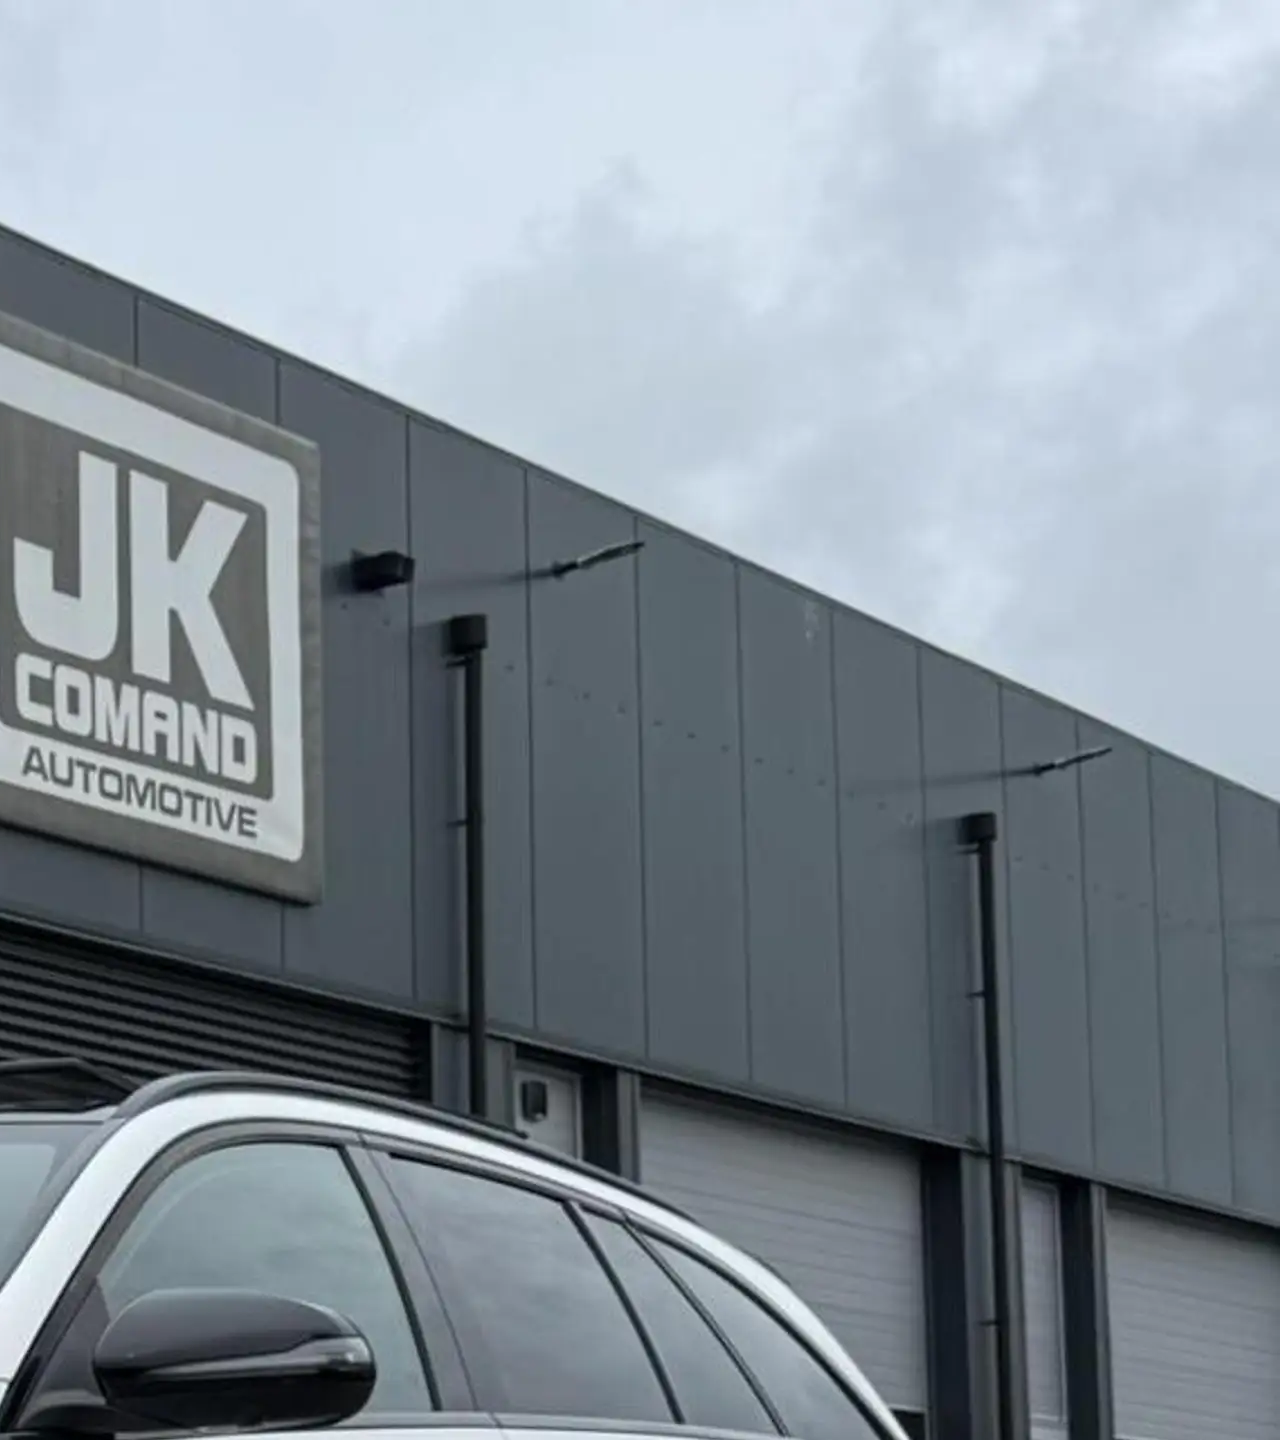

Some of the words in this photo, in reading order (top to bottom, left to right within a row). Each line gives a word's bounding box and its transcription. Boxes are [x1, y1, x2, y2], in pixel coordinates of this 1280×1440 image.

[13, 450, 255, 711] JK
[15, 652, 258, 784] COMAND
[22, 746, 258, 838] AUTOMOTIVE
